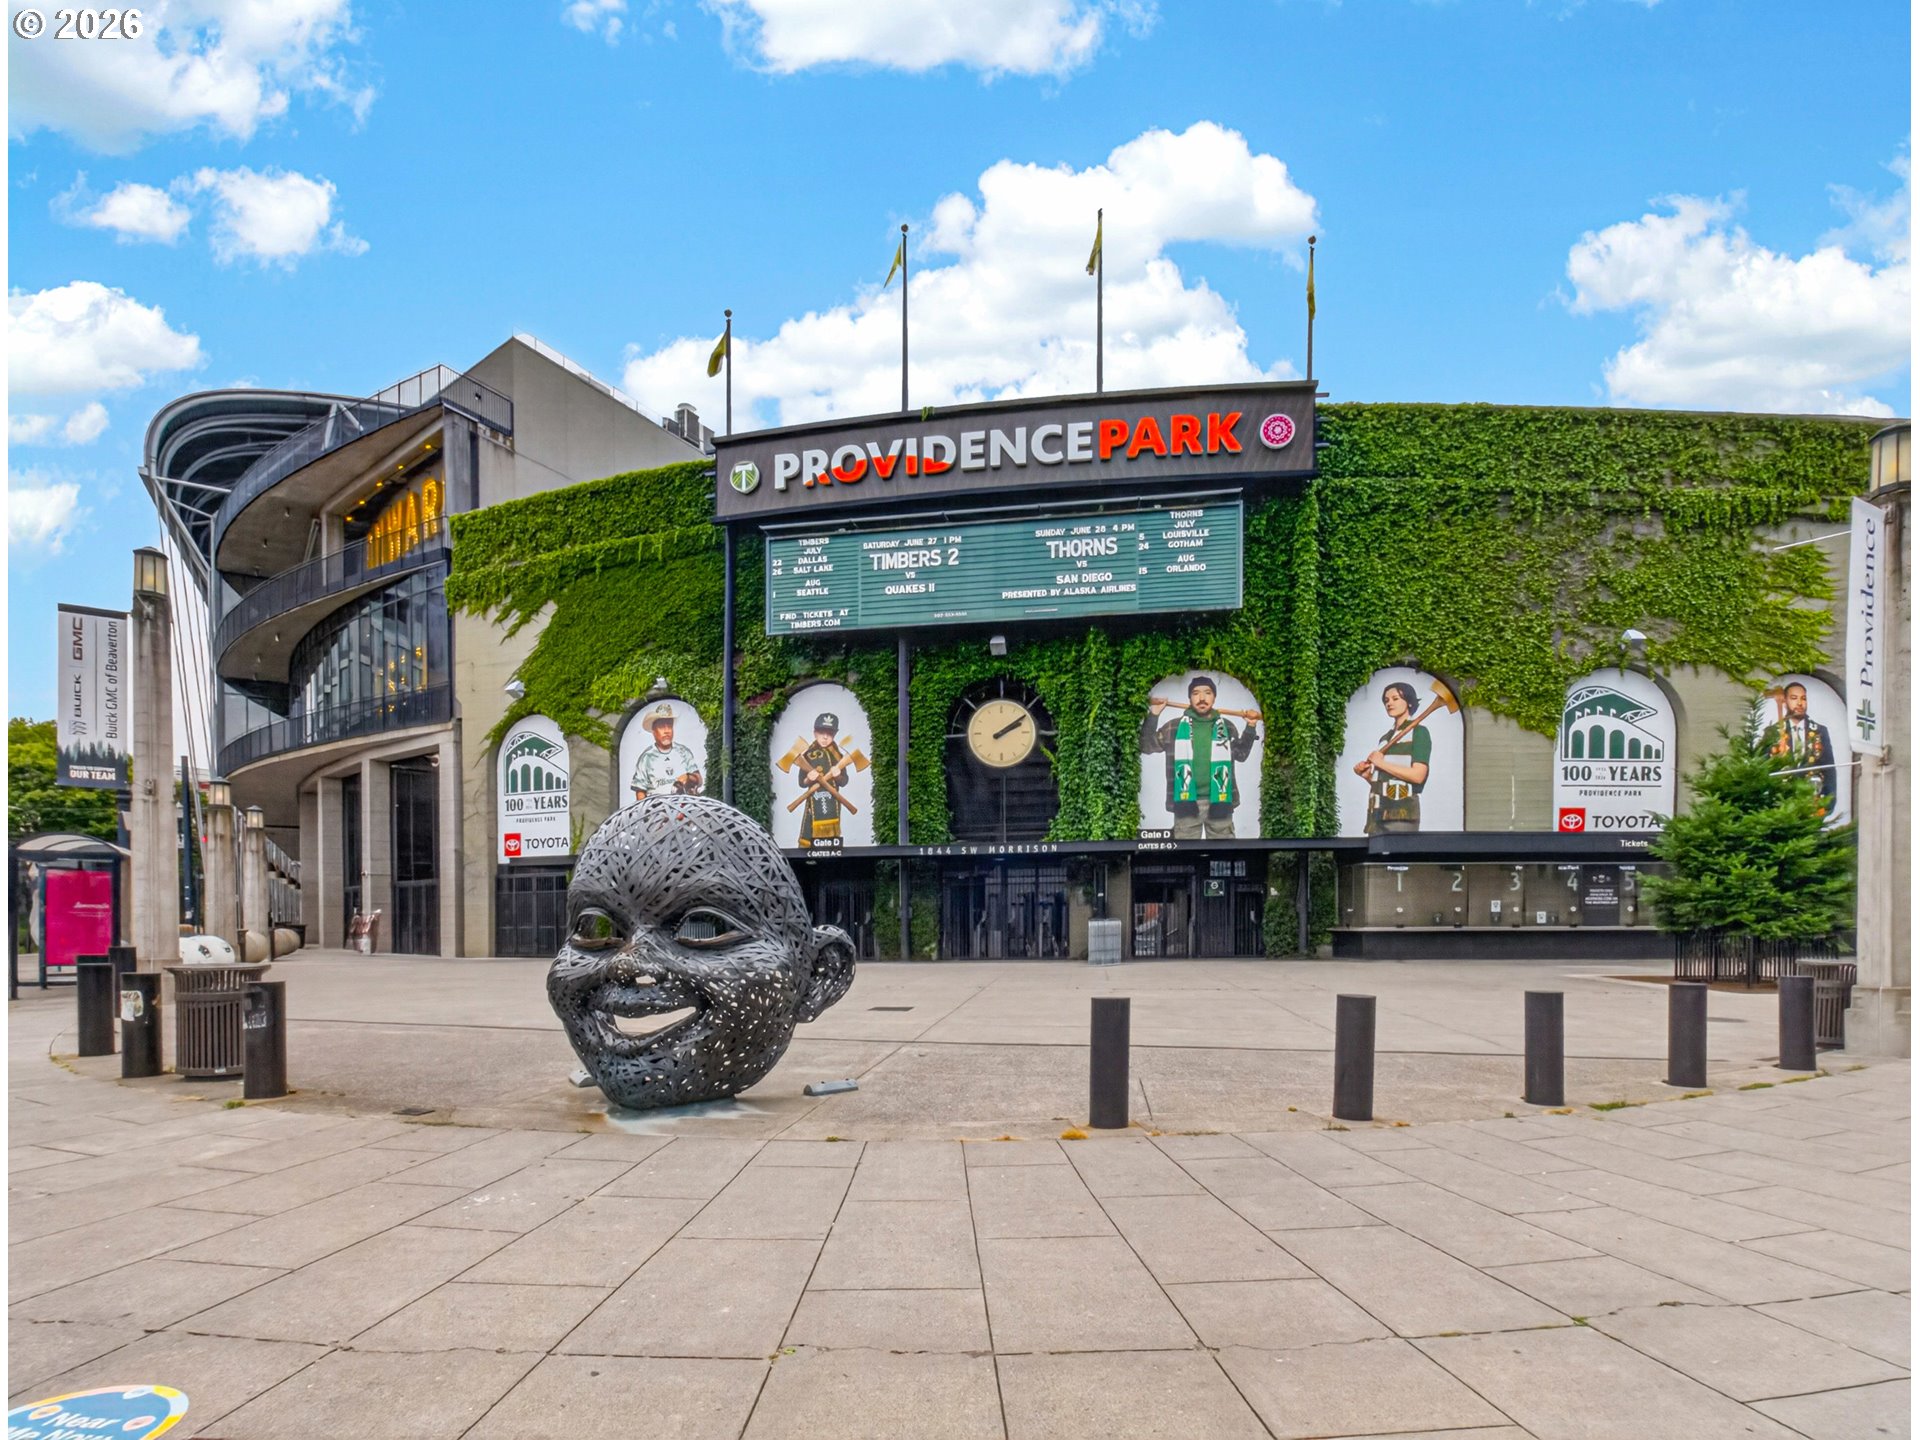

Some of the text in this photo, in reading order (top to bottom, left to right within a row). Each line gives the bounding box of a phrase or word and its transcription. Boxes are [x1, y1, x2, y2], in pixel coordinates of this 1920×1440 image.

[774, 411, 1243, 491] PROVIDENCE PARK
[1169, 509, 1204, 519] THORNS
[1174, 519, 1196, 529] JULY
[1035, 523, 1135, 538] SUNDAY JUNE 28 4 PM
[1138, 528, 1210, 541] 5 LOUISVILLE
[798, 537, 830, 546] TIMBERS
[863, 540, 900, 549] SATURDAY
[904, 538, 924, 547] JUNE
[927, 537, 938, 545] 27
[949, 535, 962, 544] PM
[1138, 539, 1204, 551] 24 GOTHAM
[803, 546, 823, 555] JULY
[1046, 537, 1118, 559] THORNS
[772, 555, 828, 567] 22 DALLAS
[869, 547, 960, 571] TIMBERS 2
[1076, 560, 1088, 568] VS
[1177, 554, 1195, 563] AUG
[772, 564, 834, 576] 26 SALT LAKE
[1166, 563, 1207, 573] ORLANDO
[905, 571, 916, 579] VS
[1056, 572, 1113, 585] SAN DIEGO
[805, 579, 821, 587] AUG
[796, 587, 829, 597] SEATTLE
[885, 584, 926, 595] QUAKES
[1002, 584, 1136, 599] PRESENTED BY ALASKA AIRLINES
[1859, 518, 1876, 688] Providence
[780, 608, 849, 621] FIND TICKETS AT
[790, 618, 841, 629] TIMBERS.COM
[72, 617, 83, 661] GMC
[105, 621, 118, 739] Buick GMC of Beaverton
[69, 769, 116, 781] OUR TEAM
[1561, 765, 1592, 781] 100
[1608, 766, 1662, 782] YEARS
[1579, 789, 1642, 797] PROVIDENCE PARK
[505, 798, 524, 812] 100
[533, 794, 568, 810] YEARS
[1592, 815, 1660, 829] TOYOTA
[1141, 830, 1171, 839] Gate D
[524, 836, 569, 850] TOYOTA
[813, 838, 840, 847] Gate D
[1620, 839, 1649, 848] Tickets
[919, 844, 1058, 856] 1844 SW MORRISON
[1397, 872, 1402, 892] 1
[1451, 872, 1463, 892] 2
[1510, 871, 1521, 891] 3
[1566, 872, 1578, 892] 4
[1624, 871, 1635, 891] 5
